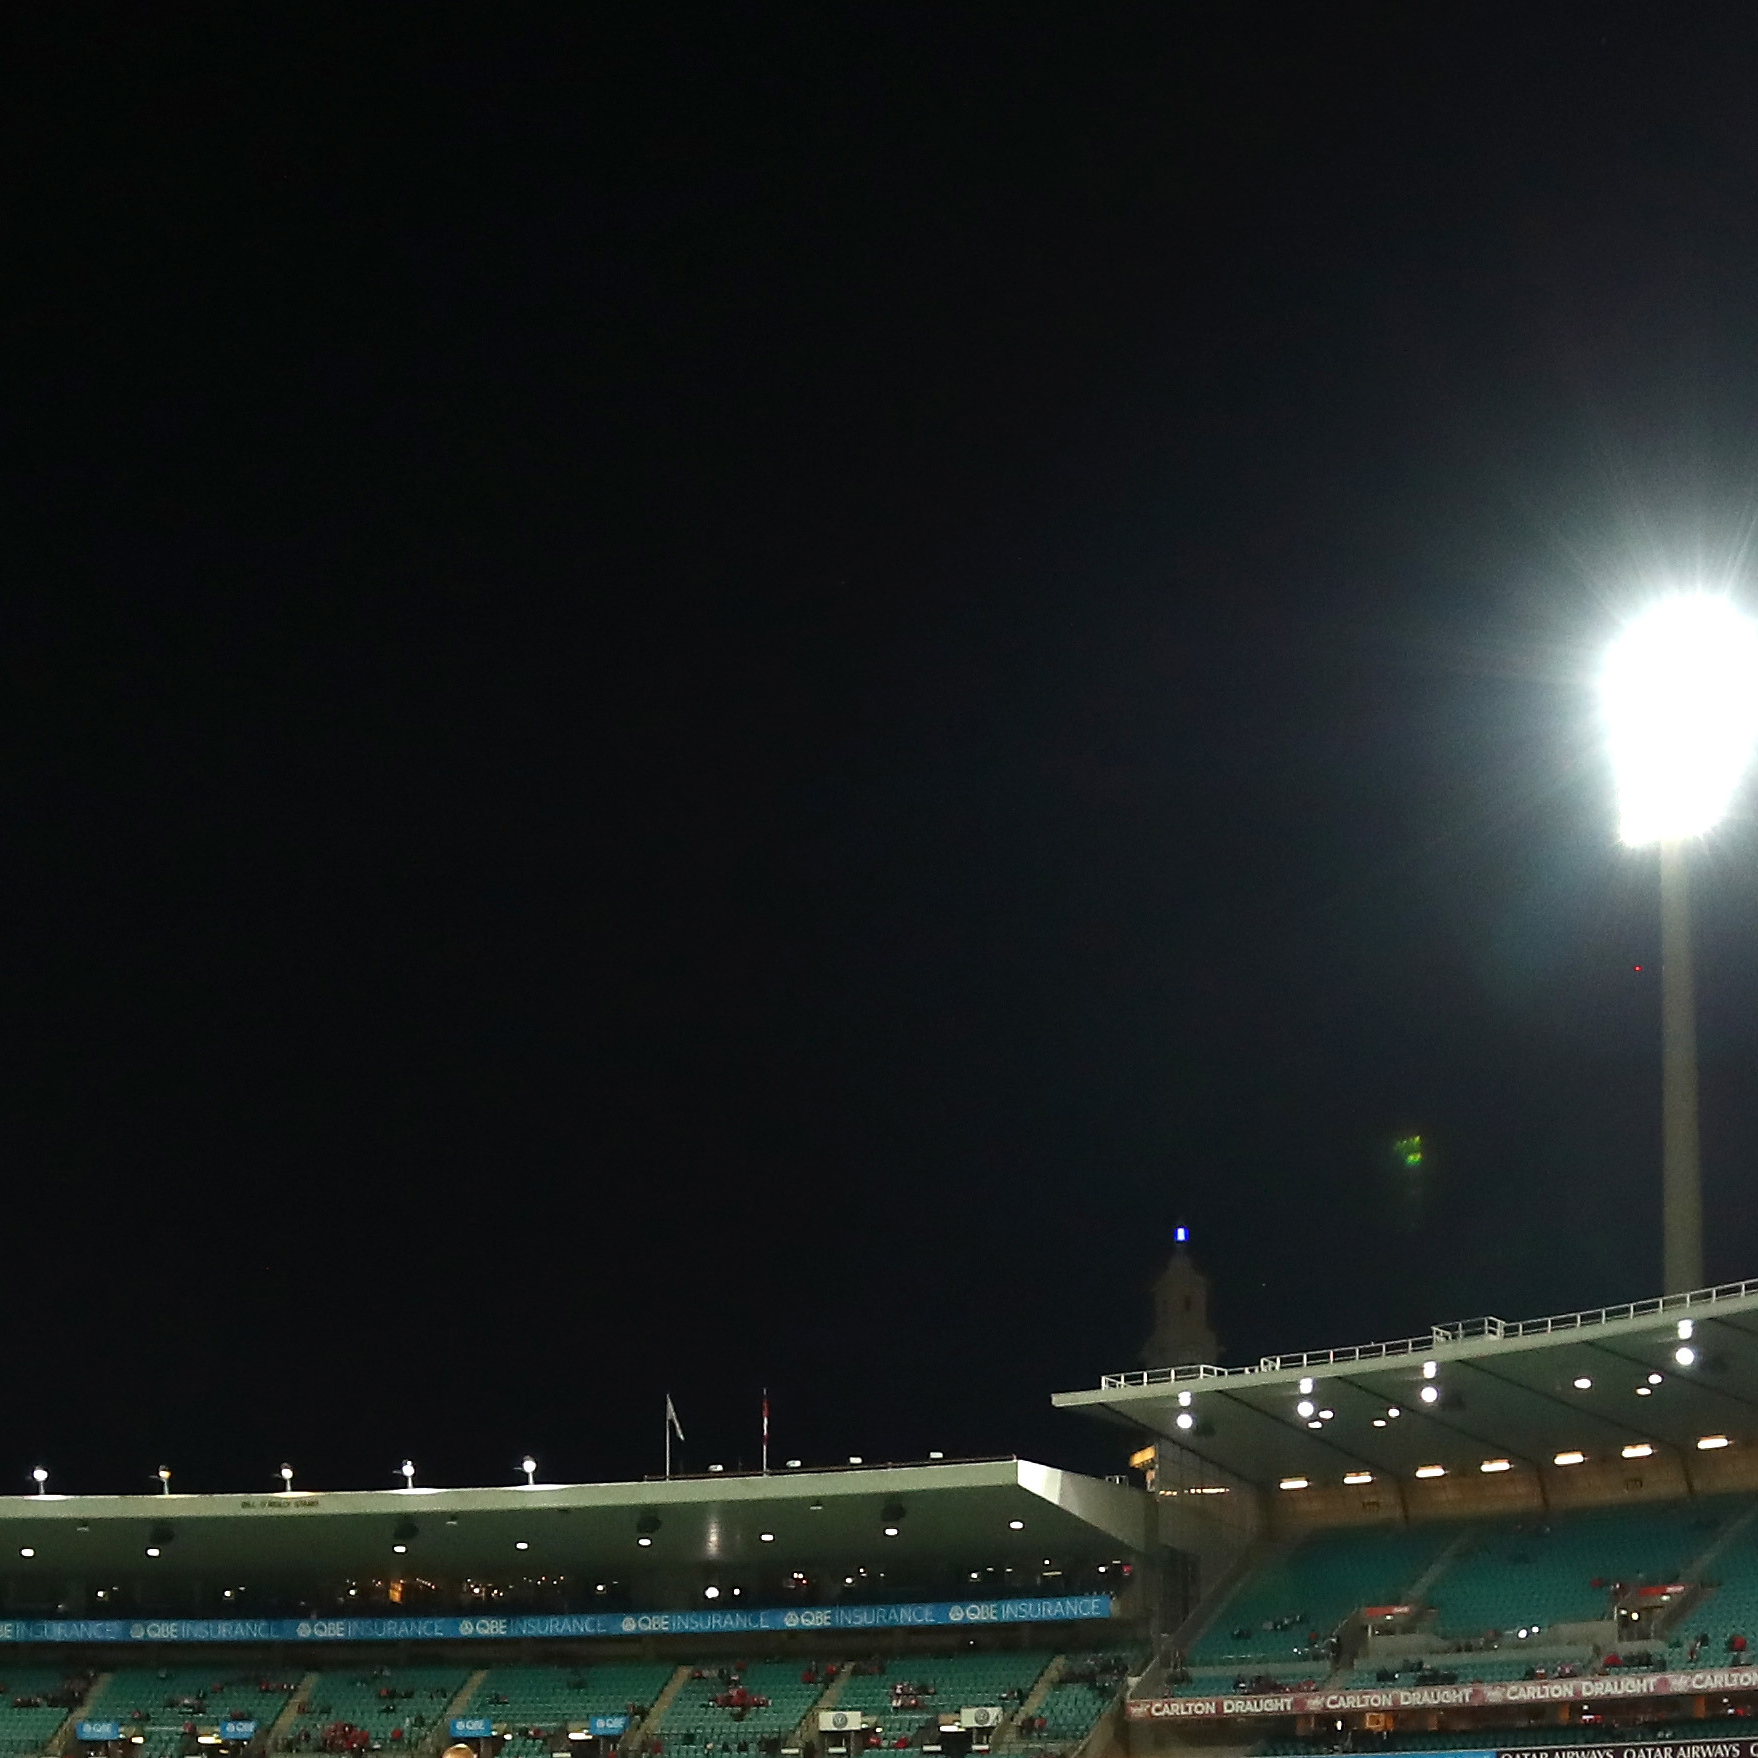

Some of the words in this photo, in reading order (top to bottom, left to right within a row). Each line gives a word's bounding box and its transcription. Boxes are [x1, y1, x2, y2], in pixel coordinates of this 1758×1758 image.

[801, 1610, 831, 1626] QBE
[836, 1606, 935, 1625] INSURANCE
[966, 1605, 997, 1620] QBE
[1002, 1599, 1100, 1618] INSURANCE
[146, 1623, 177, 1638] QBE
[314, 1622, 344, 1637] QBE
[348, 1620, 442, 1636] INSURANCE
[476, 1619, 507, 1635] QBE
[510, 1617, 606, 1634] INSURANCE
[638, 1615, 668, 1631] QBE
[672, 1612, 770, 1630] INSURANCE
[1327, 1694, 1392, 1710] CARLTON
[1400, 1688, 1473, 1705] DRAUGHT
[1507, 1683, 1573, 1700] CARLTON
[1581, 1678, 1656, 1696] DRAUGHT
[1151, 1702, 1215, 1718] CARLTON
[1223, 1698, 1292, 1714] DRAUGHT
